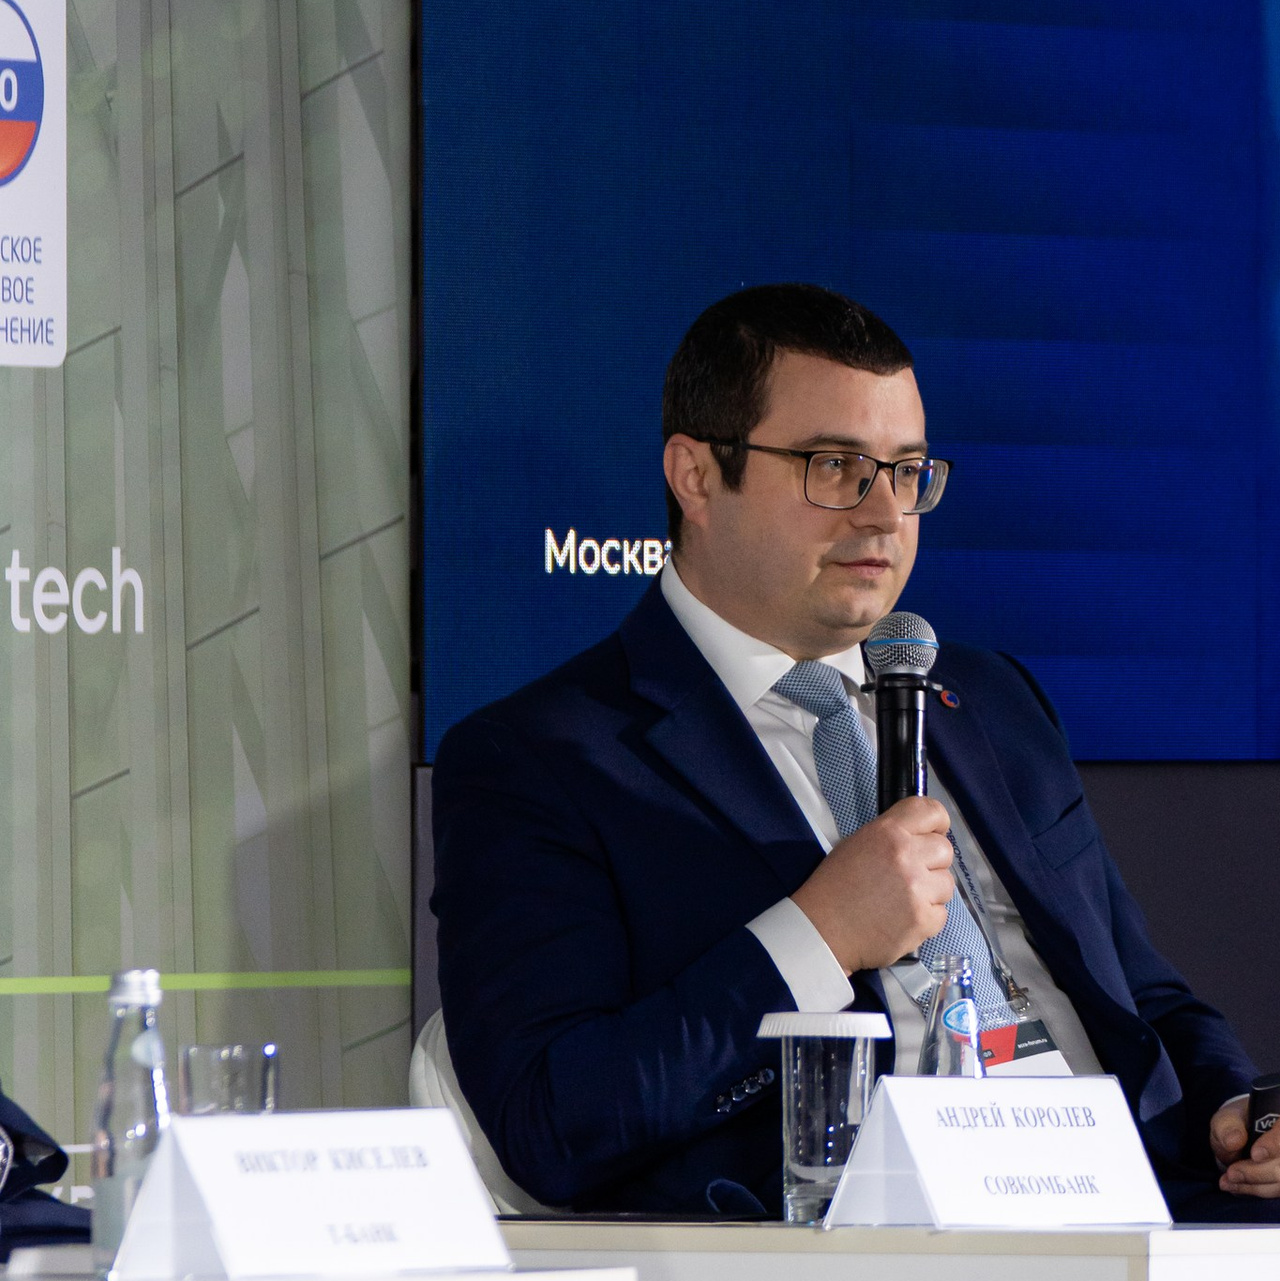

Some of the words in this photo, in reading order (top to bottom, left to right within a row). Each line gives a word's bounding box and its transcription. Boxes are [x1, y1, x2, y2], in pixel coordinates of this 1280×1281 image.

[5, 546, 144, 634] tech
[936, 1102, 1006, 1130] АНДРЕЙ
[1010, 1106, 1097, 1128] КОРОЛЕВ
[983, 1175, 1101, 1195] СОВКОМБАНК
